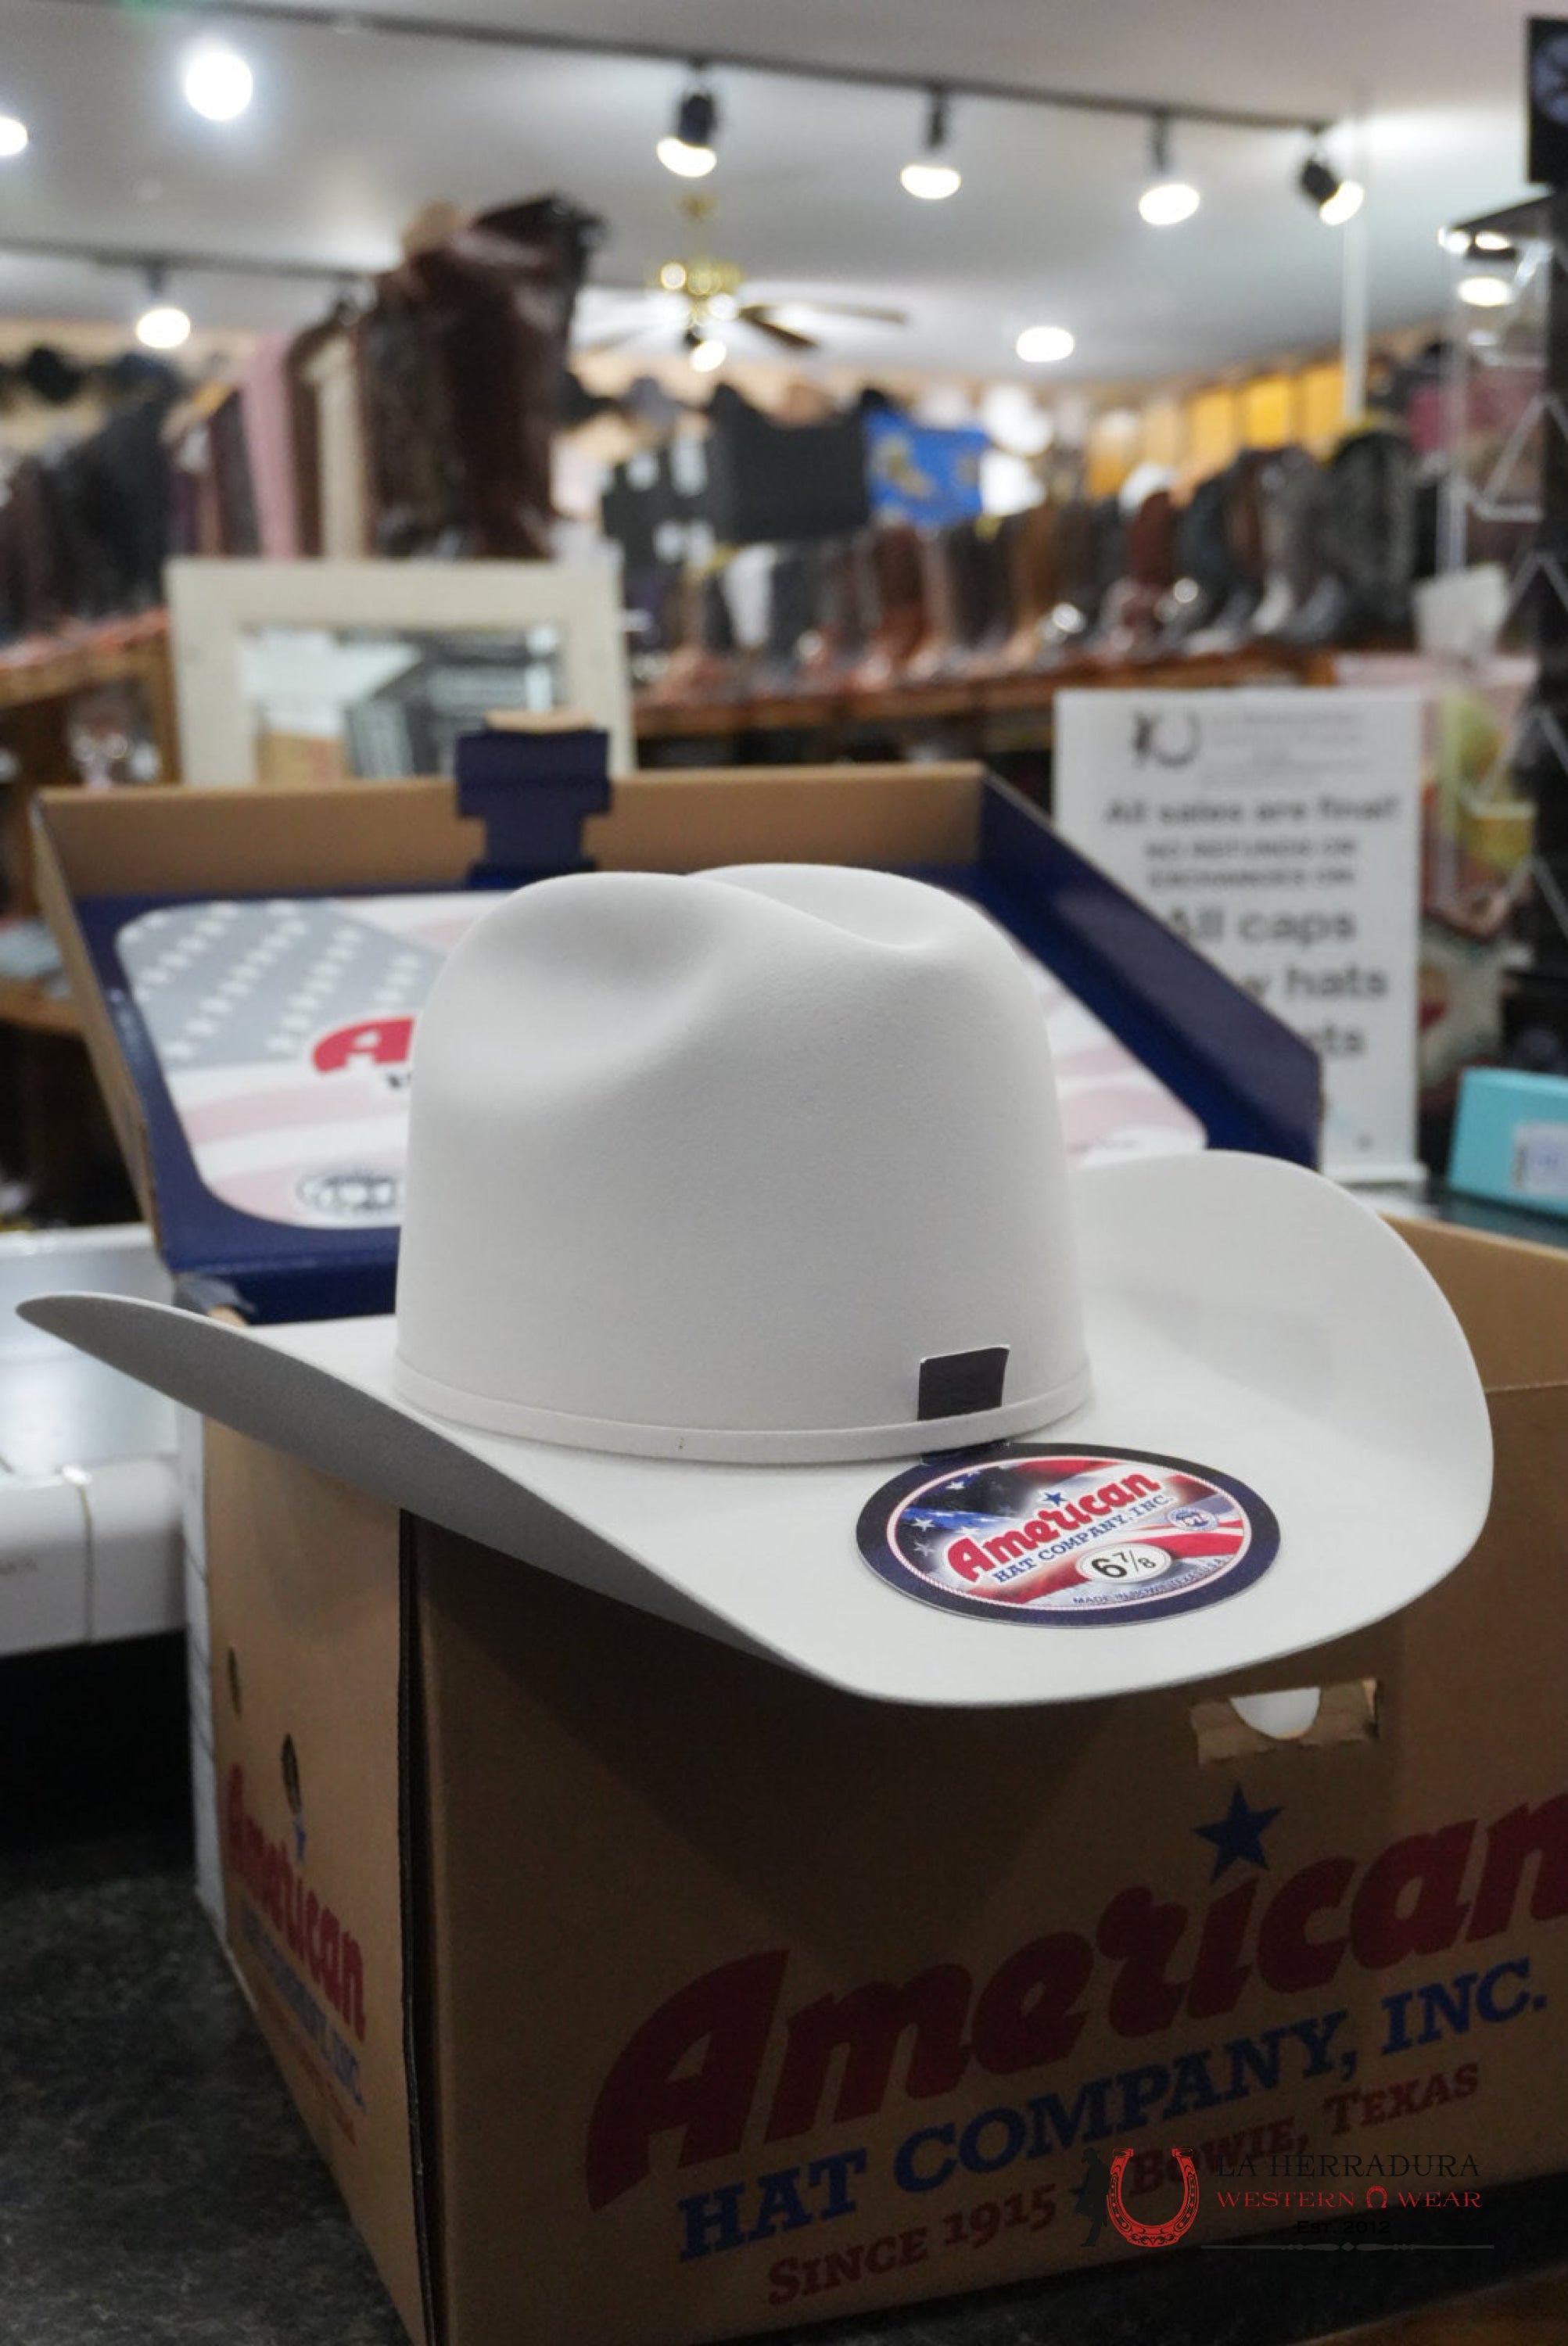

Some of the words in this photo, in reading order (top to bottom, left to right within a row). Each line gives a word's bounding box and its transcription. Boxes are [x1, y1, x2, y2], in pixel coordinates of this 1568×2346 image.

[1238, 912, 1357, 946] caps
[1285, 963, 1387, 999] hats
[947, 1473, 1161, 1583] American
[992, 1557, 1037, 1583] HAT
[587, 1792, 1568, 2213] American
[677, 2147, 867, 2262] HAT
[894, 2010, 1358, 2197] COMPANY,
[1381, 1958, 1548, 2055] INC.
[768, 2226, 928, 2306] SINCE
[942, 2183, 1057, 2249] 1915
[1128, 2116, 1310, 2197] BWIE,
[1324, 2063, 1479, 2136] TEXAS
